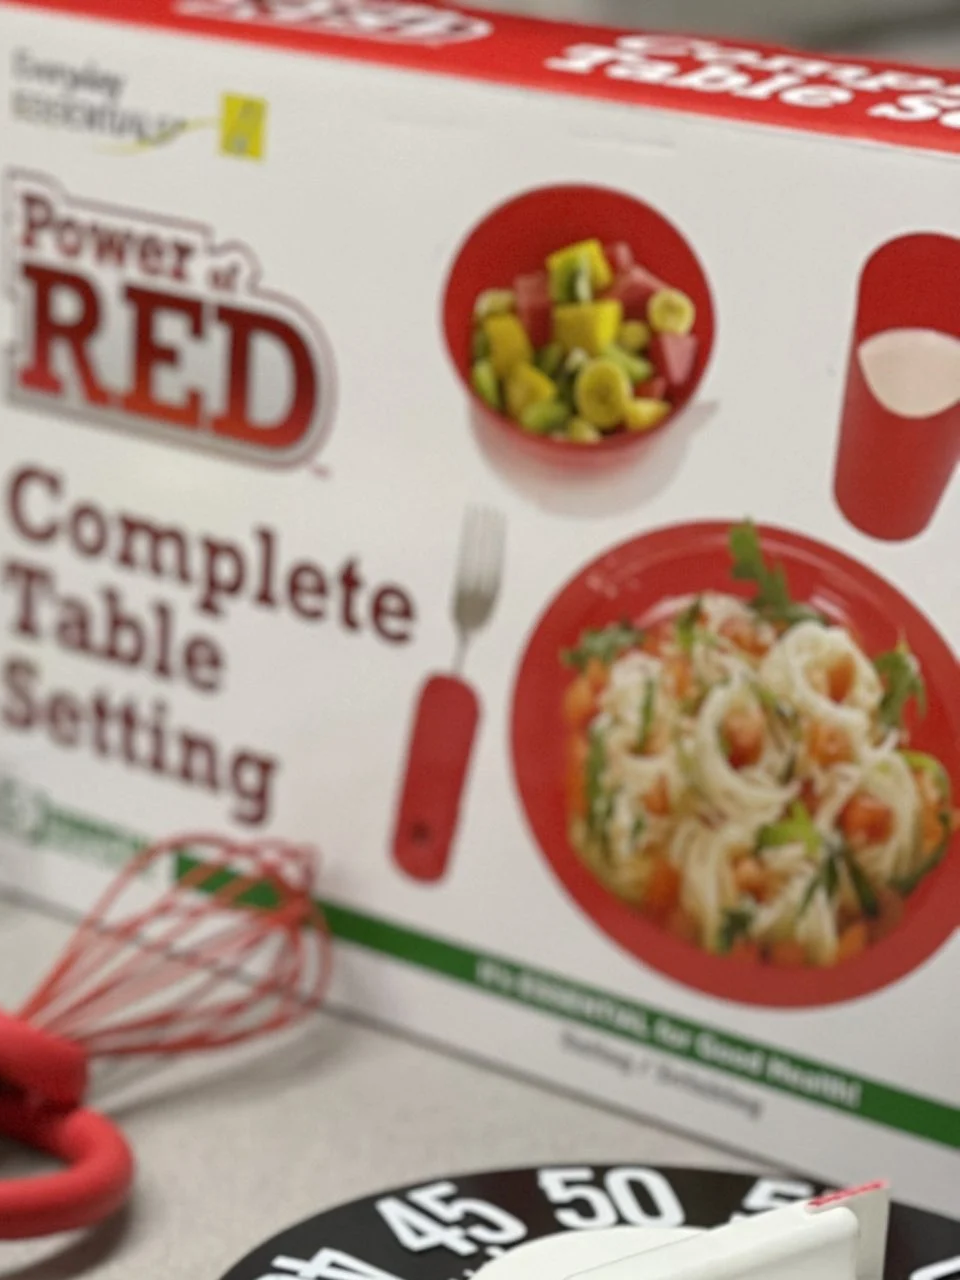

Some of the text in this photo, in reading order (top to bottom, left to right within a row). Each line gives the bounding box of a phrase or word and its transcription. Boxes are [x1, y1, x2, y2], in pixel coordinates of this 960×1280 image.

[19, 194, 240, 291] Power of
[18, 262, 316, 449] RED
[8, 466, 417, 645] Complete
[2, 560, 224, 694] Table
[1, 656, 280, 827] Setting
[375, 1182, 528, 1256] 45
[538, 1166, 686, 1229] 50
